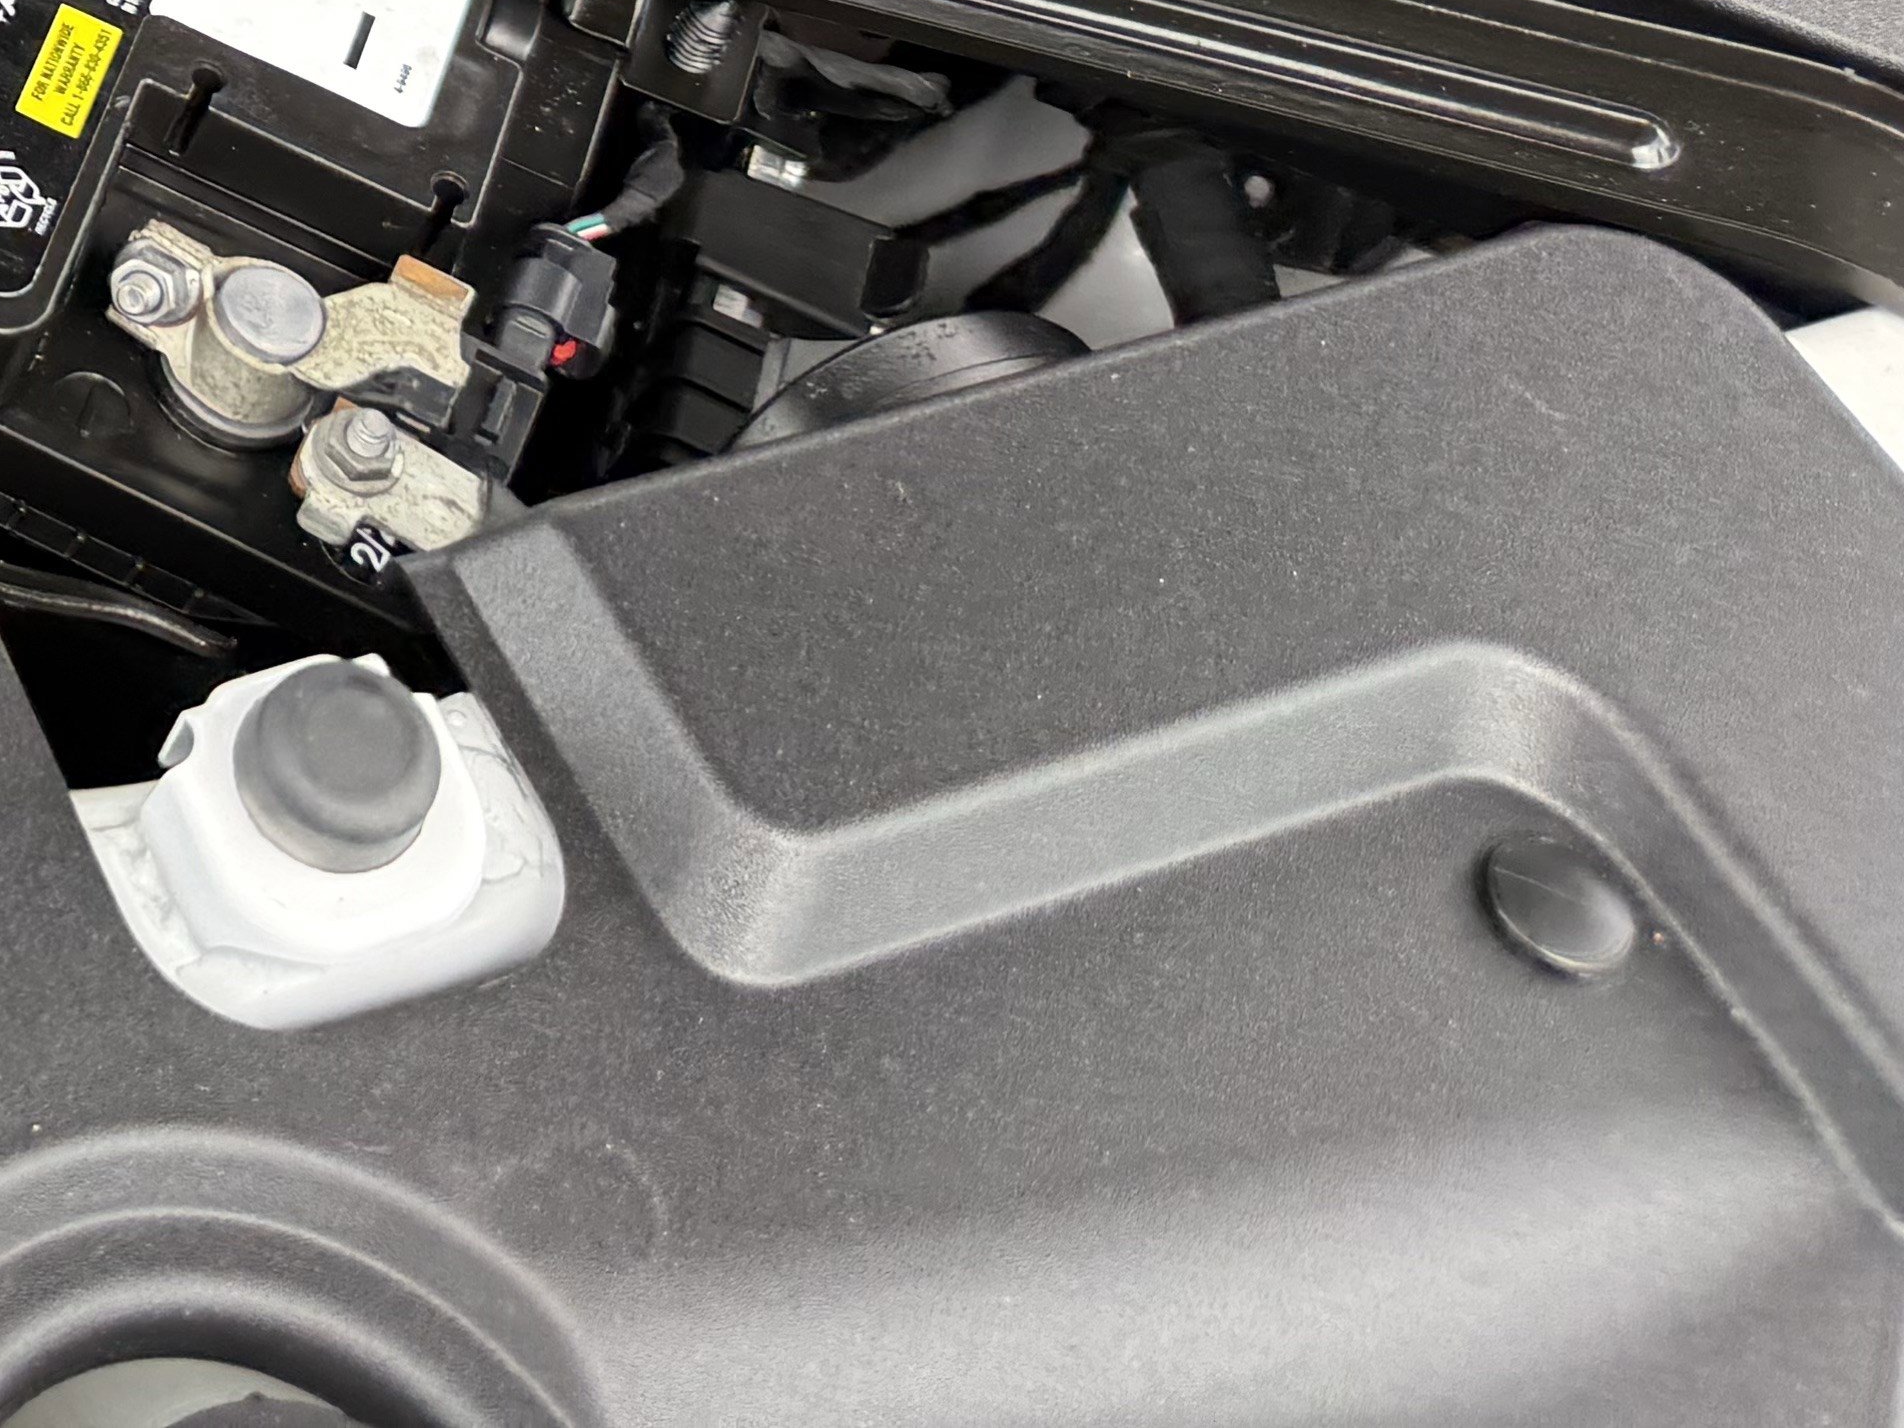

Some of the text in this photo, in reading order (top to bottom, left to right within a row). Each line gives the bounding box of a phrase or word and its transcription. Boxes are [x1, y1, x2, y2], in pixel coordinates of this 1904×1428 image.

[29, 21, 76, 101] FOR NATIONWIDE
[51, 41, 87, 96] WARRANTY
[58, 99, 81, 127] CALL
